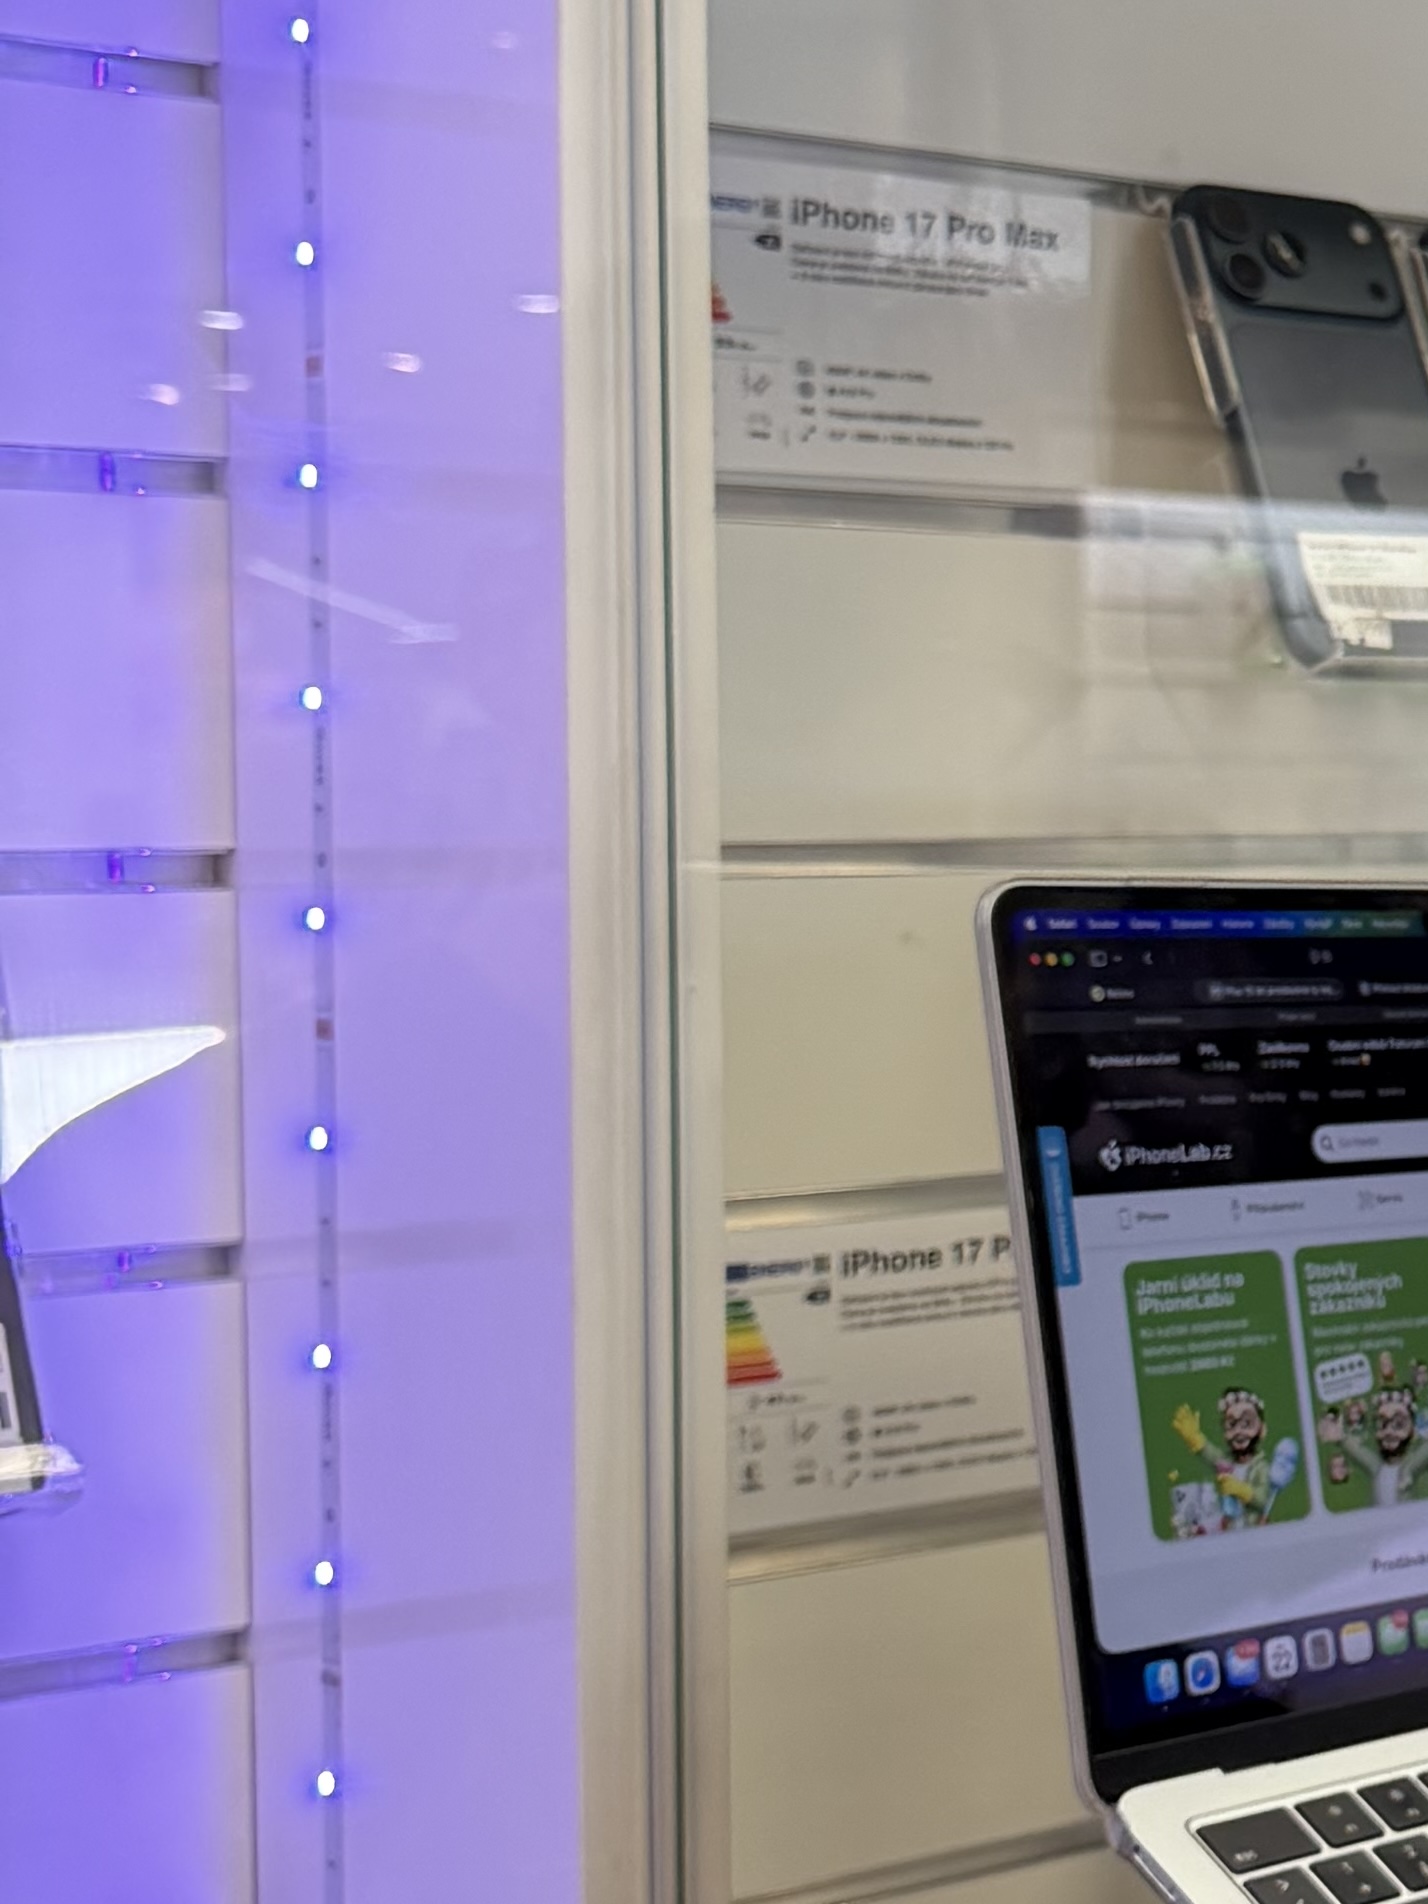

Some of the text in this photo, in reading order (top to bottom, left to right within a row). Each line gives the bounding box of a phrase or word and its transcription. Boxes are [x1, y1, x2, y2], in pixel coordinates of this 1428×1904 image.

[790, 199, 895, 235] iPhone
[905, 210, 937, 235] 17
[946, 213, 995, 245] Pro
[1004, 220, 1061, 251] Max
[842, 1249, 942, 1278] iPhone
[951, 1237, 985, 1266] 17
